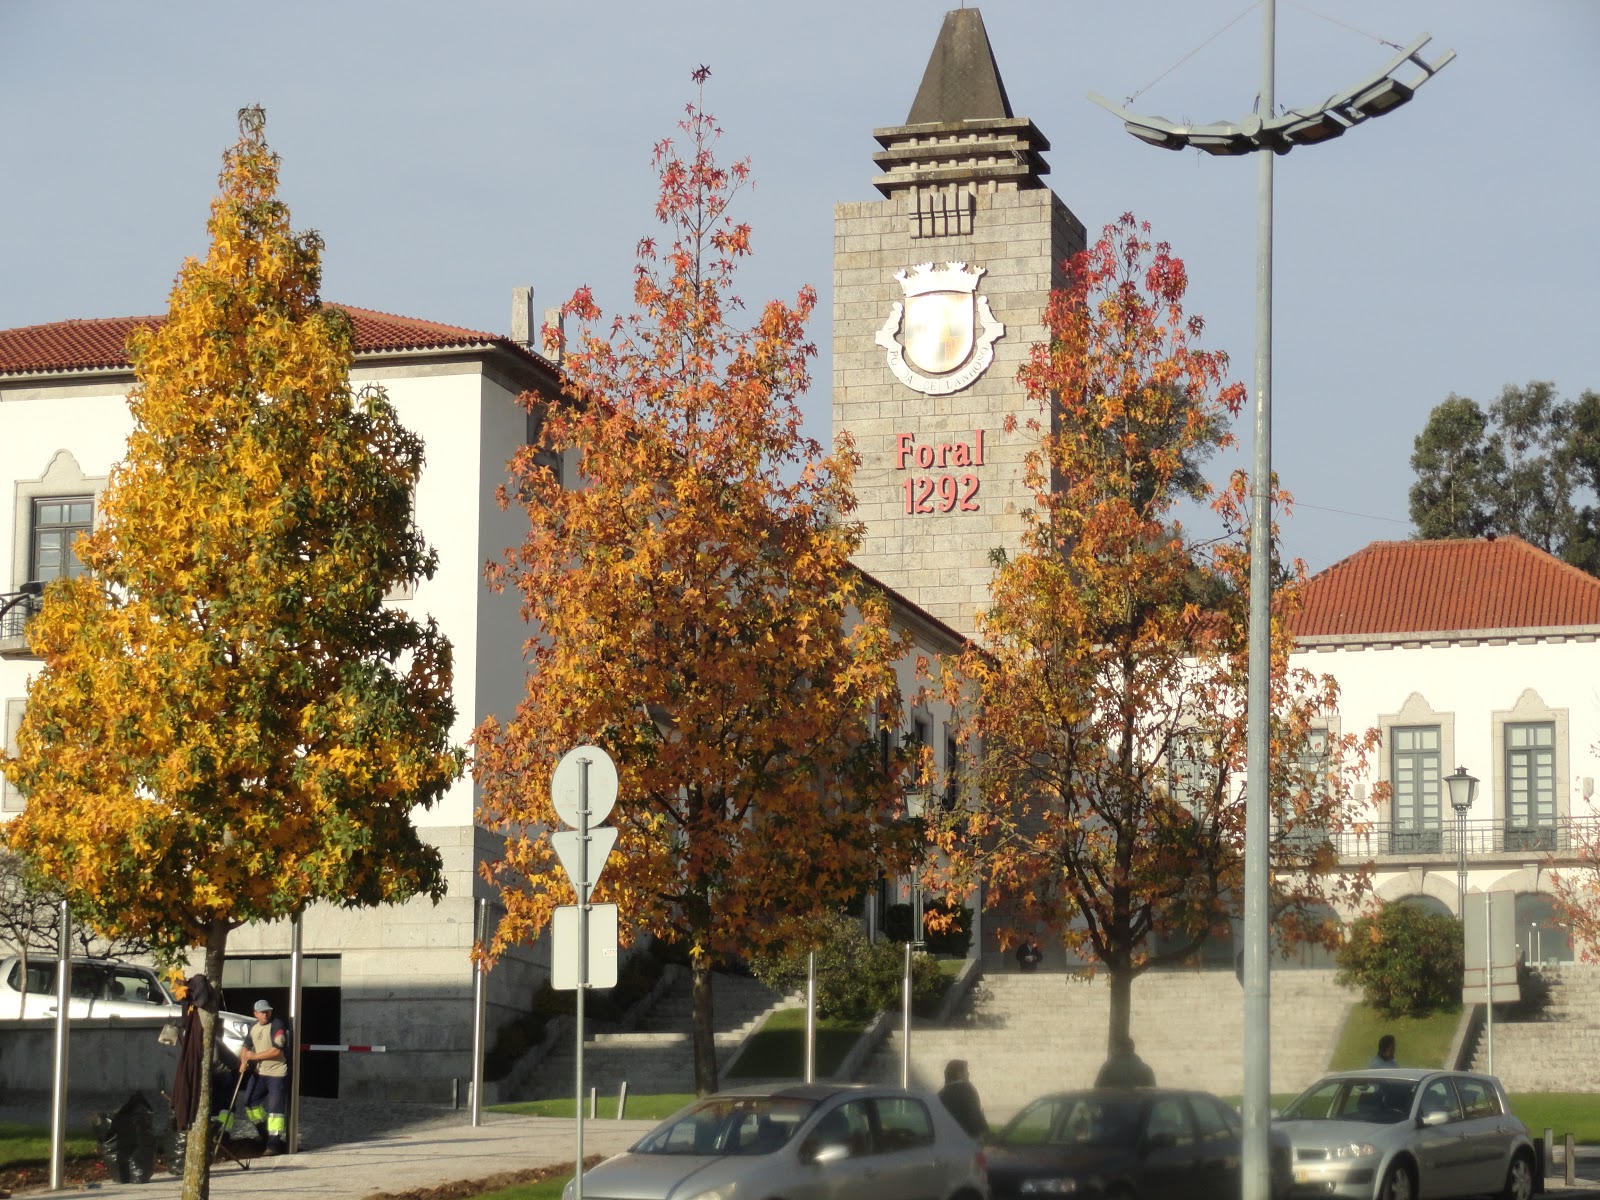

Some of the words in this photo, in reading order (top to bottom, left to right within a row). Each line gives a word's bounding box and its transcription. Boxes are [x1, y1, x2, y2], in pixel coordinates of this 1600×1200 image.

[923, 381, 937, 391] DE
[945, 347, 989, 390] LANHOSO
[896, 429, 985, 470] Foral
[902, 474, 980, 514] 1292
